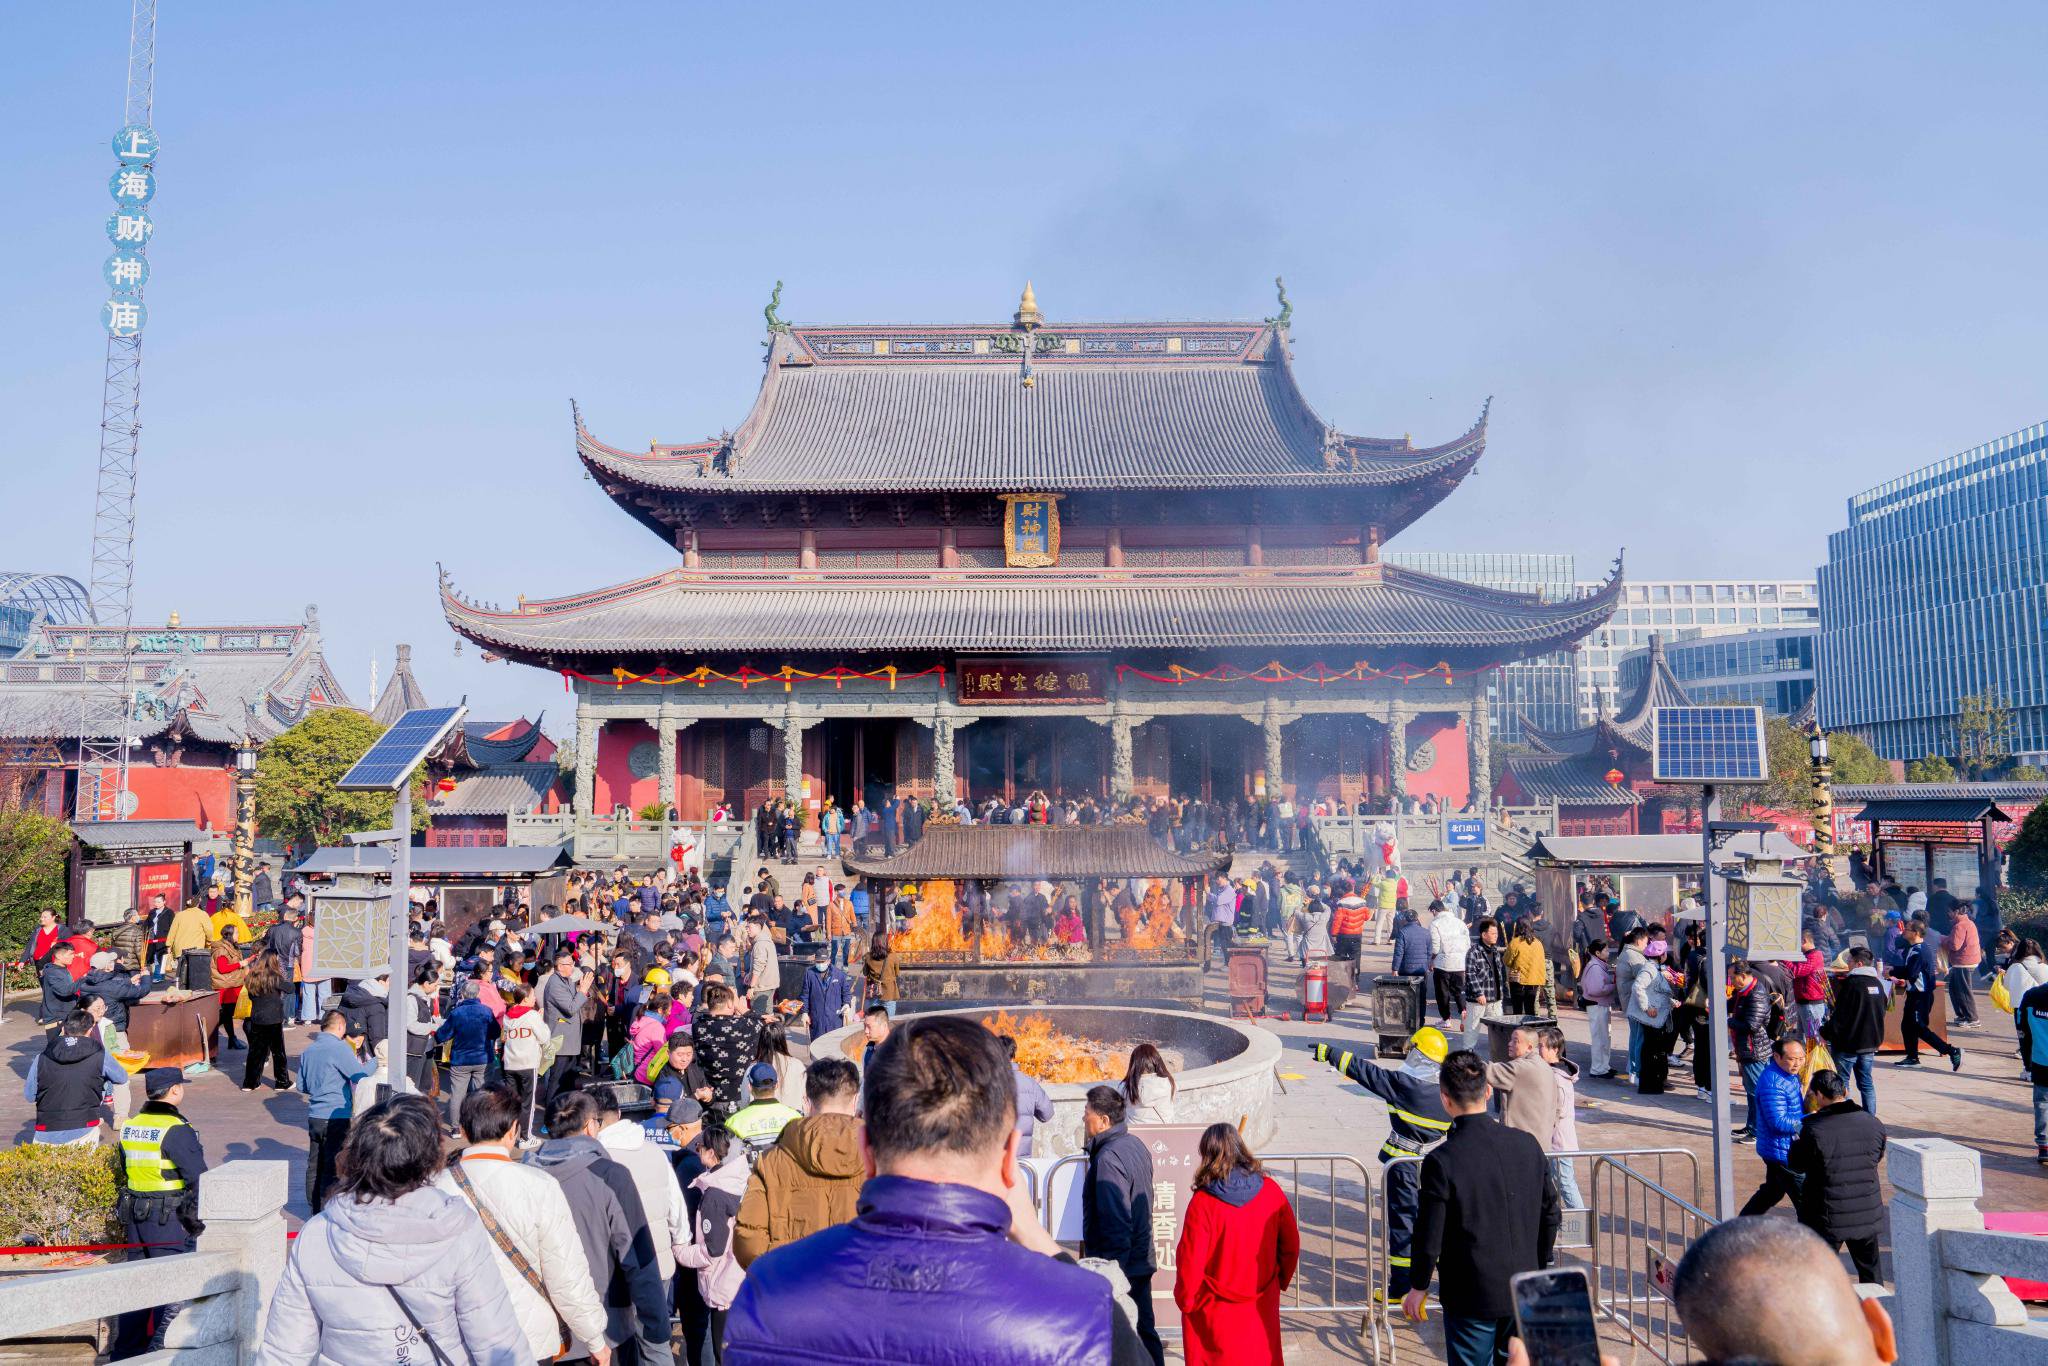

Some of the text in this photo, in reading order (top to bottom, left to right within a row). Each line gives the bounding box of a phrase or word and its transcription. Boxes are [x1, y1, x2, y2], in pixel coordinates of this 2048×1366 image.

[109, 131, 150, 328] 上海财神庙
